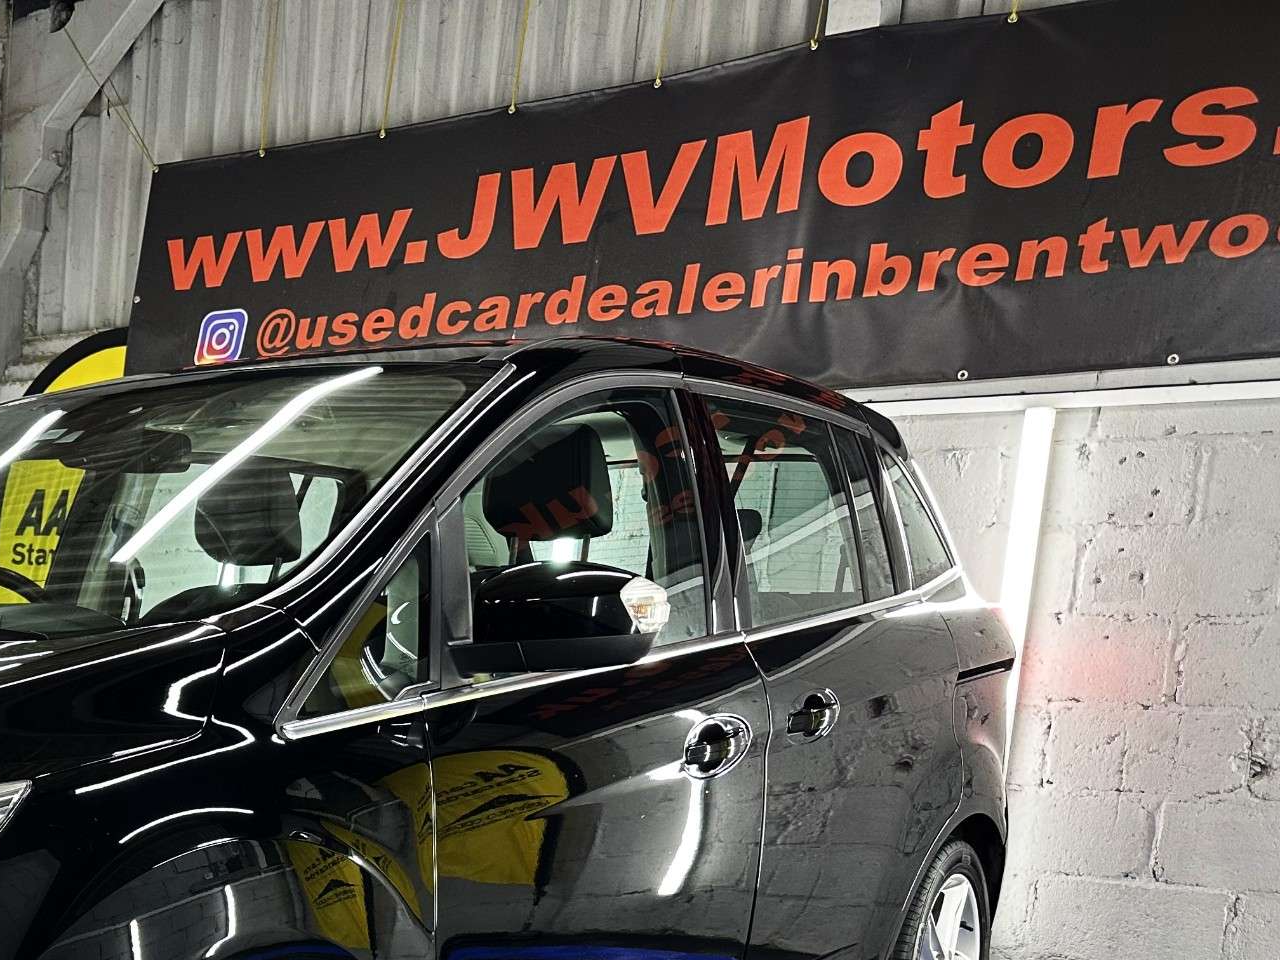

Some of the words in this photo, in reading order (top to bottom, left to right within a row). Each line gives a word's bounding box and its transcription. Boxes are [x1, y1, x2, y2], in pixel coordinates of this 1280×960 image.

[166, 86, 1280, 291] www.JWVMotors
[256, 213, 1280, 358] @usedcardealerinbrentwo
[15, 489, 69, 536] AA
